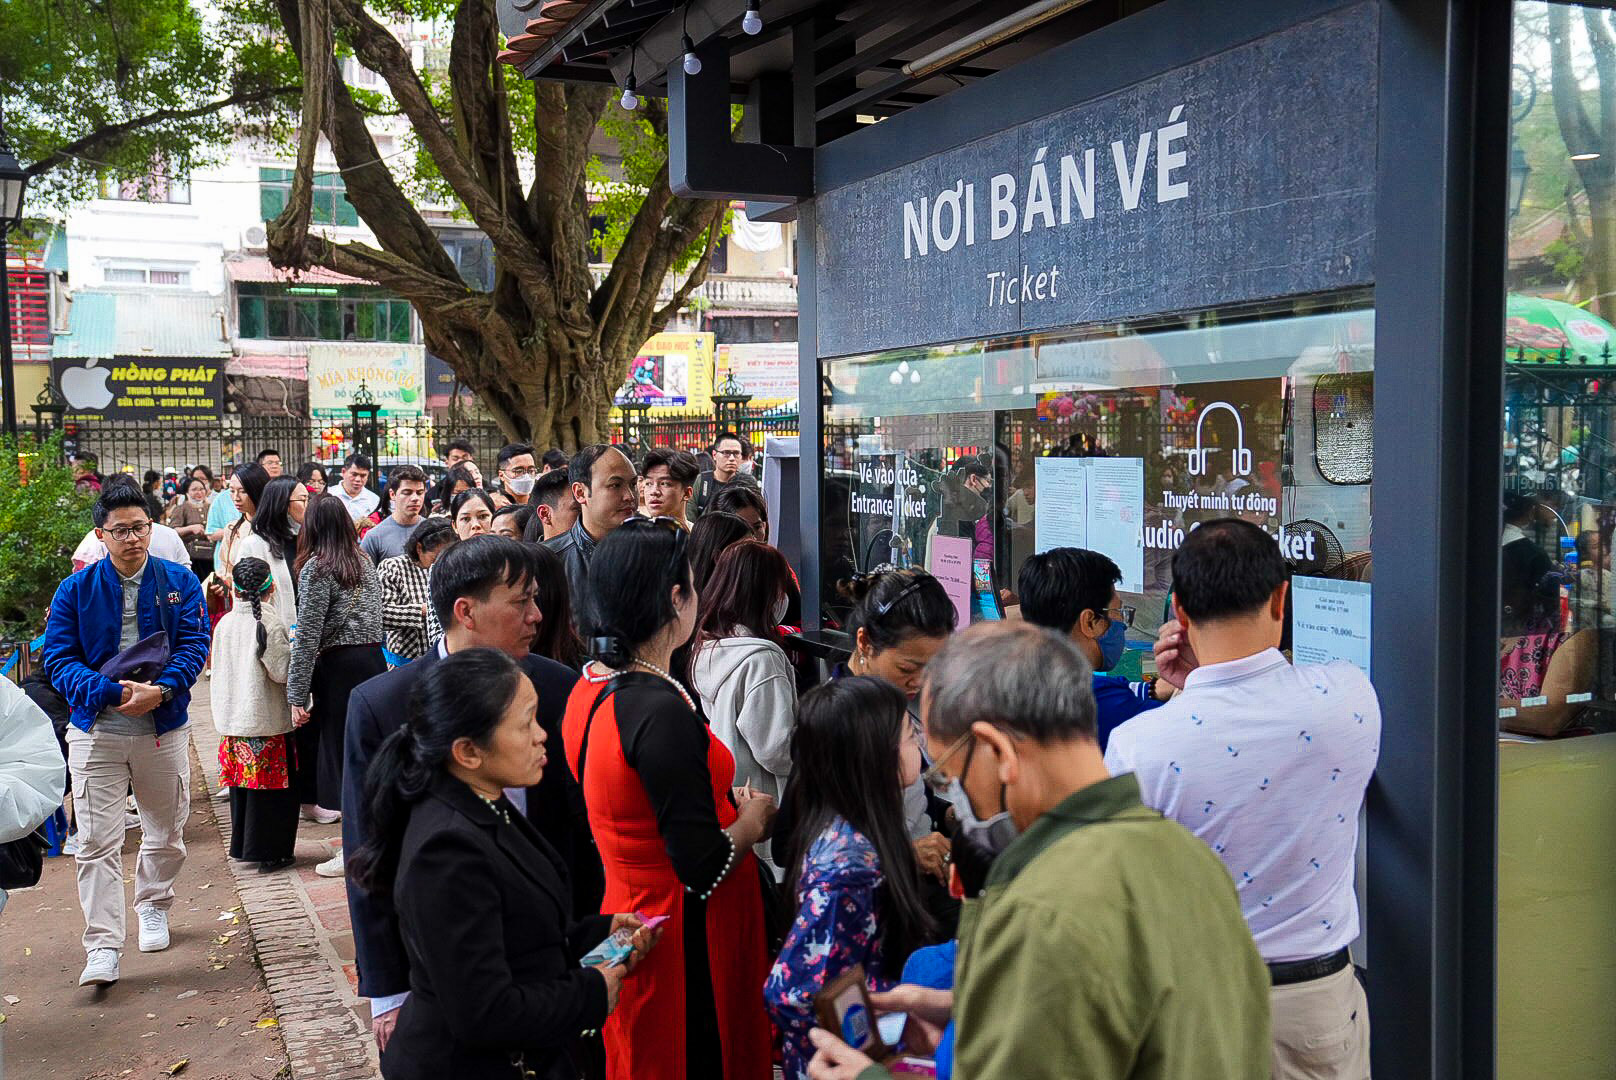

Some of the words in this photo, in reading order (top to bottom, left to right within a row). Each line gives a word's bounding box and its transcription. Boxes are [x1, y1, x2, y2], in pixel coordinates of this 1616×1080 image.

[904, 179, 974, 259] NƠI
[991, 146, 1095, 241] BÁN
[1111, 104, 1189, 211] VÉ
[987, 265, 1059, 306] Ticket
[112, 361, 167, 381] HỒNG
[170, 365, 217, 382] PHÁT
[126, 387, 152, 396] TRUNG
[153, 385, 170, 396] TÂM
[170, 387, 188, 396] MUA
[188, 386, 205, 396] BÁN
[180, 397, 196, 408] CÁC
[859, 462, 873, 484] Vé
[874, 463, 894, 485] vào
[897, 460, 918, 486] cửa
[851, 491, 893, 516] Entrance
[894, 496, 926, 518] Ticket
[1163, 489, 1199, 512] Thuyết
[1201, 490, 1230, 510] minh
[1231, 494, 1245, 515] tự
[1246, 493, 1277, 516] động
